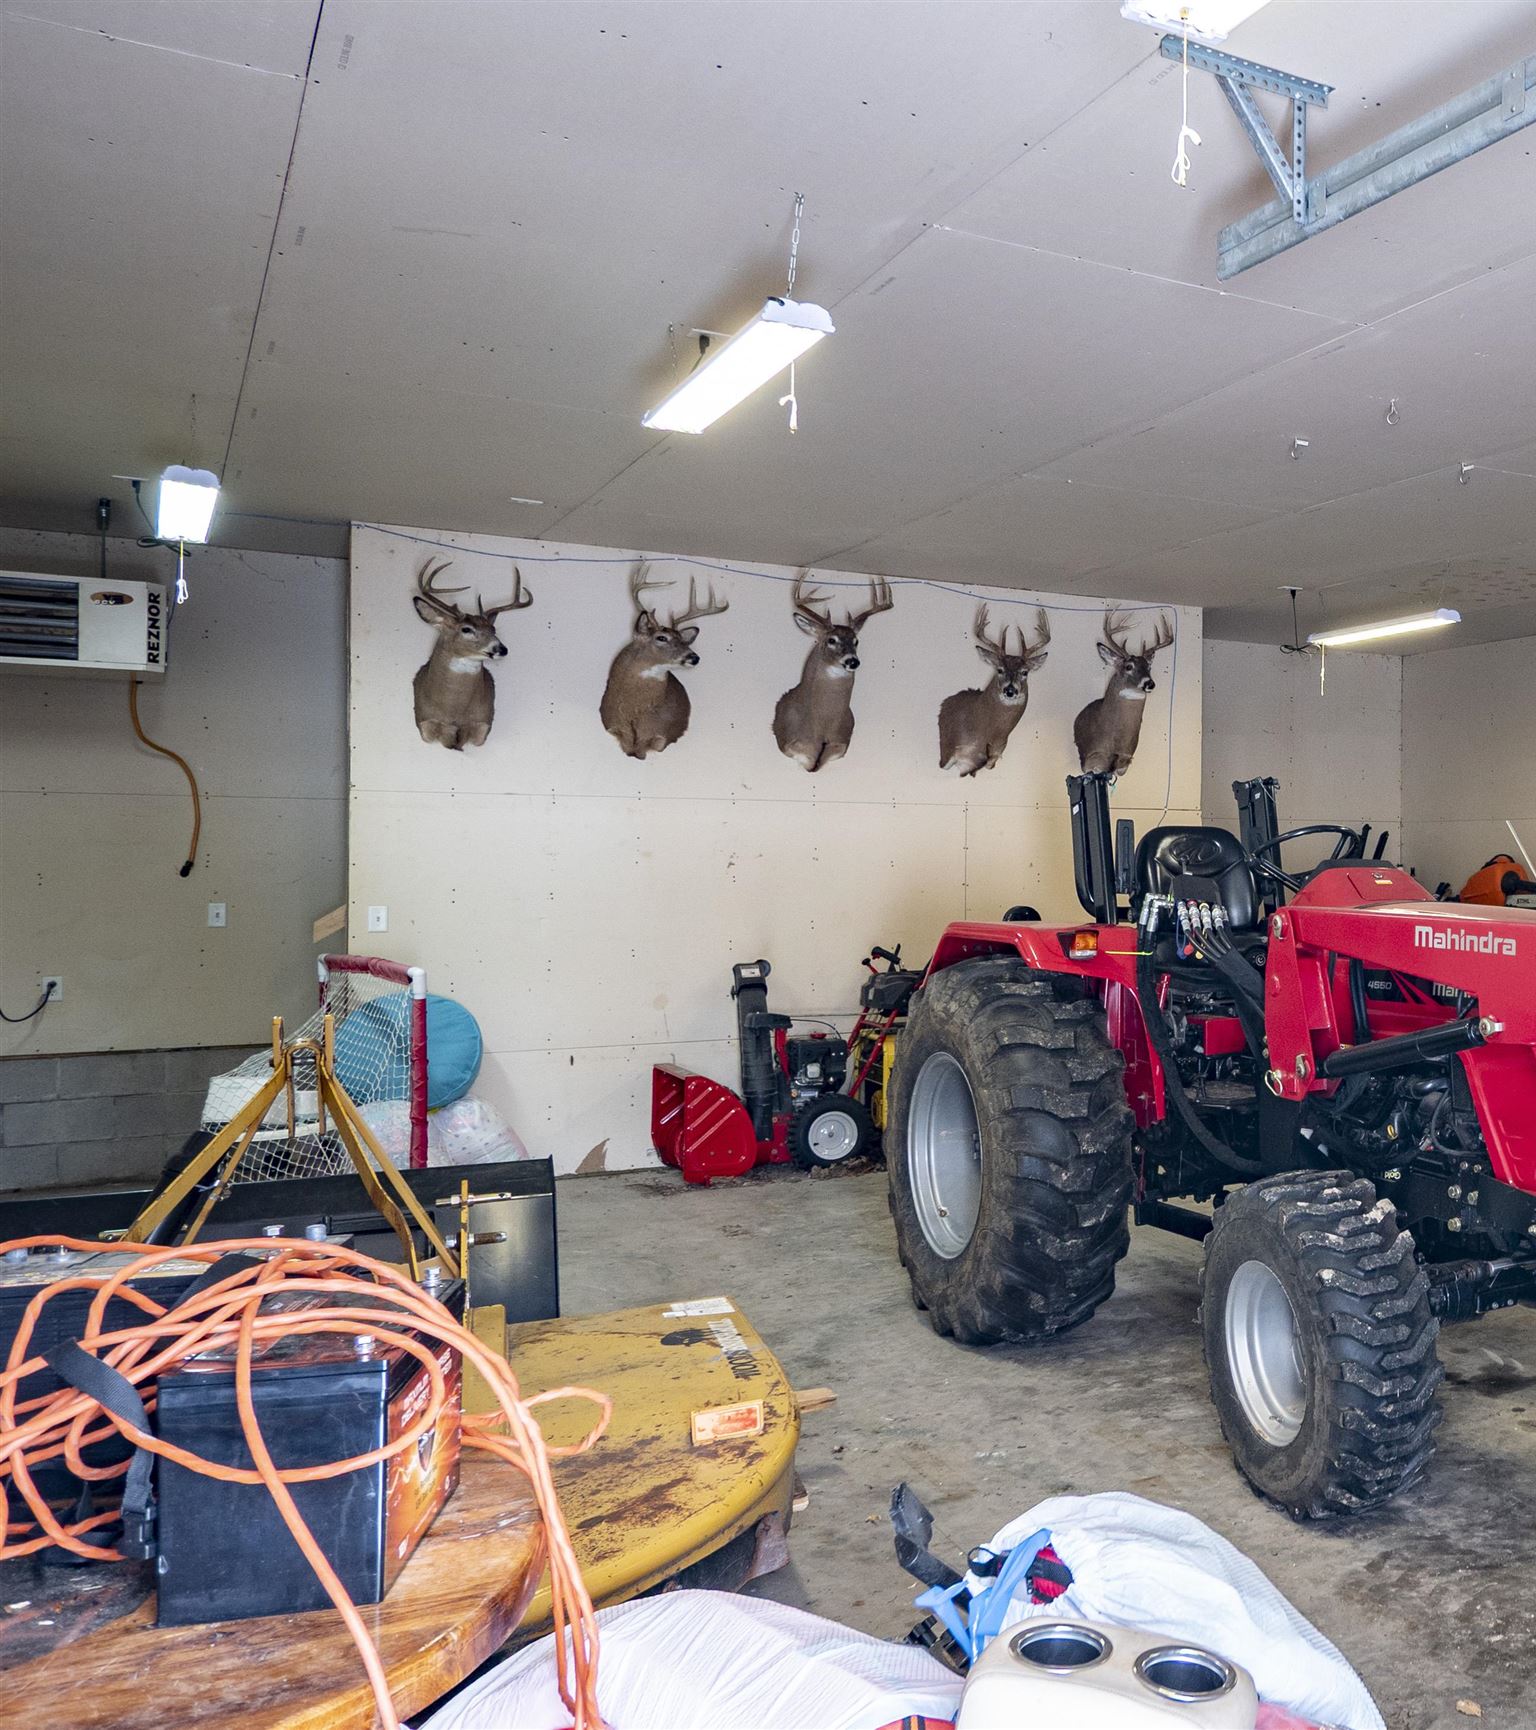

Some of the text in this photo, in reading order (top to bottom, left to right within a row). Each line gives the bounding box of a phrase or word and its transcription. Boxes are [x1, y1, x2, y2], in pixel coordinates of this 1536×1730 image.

[147, 592, 160, 664] REZNOR
[1414, 925, 1516, 956] Mahindra
[1367, 980, 1393, 991] 4550
